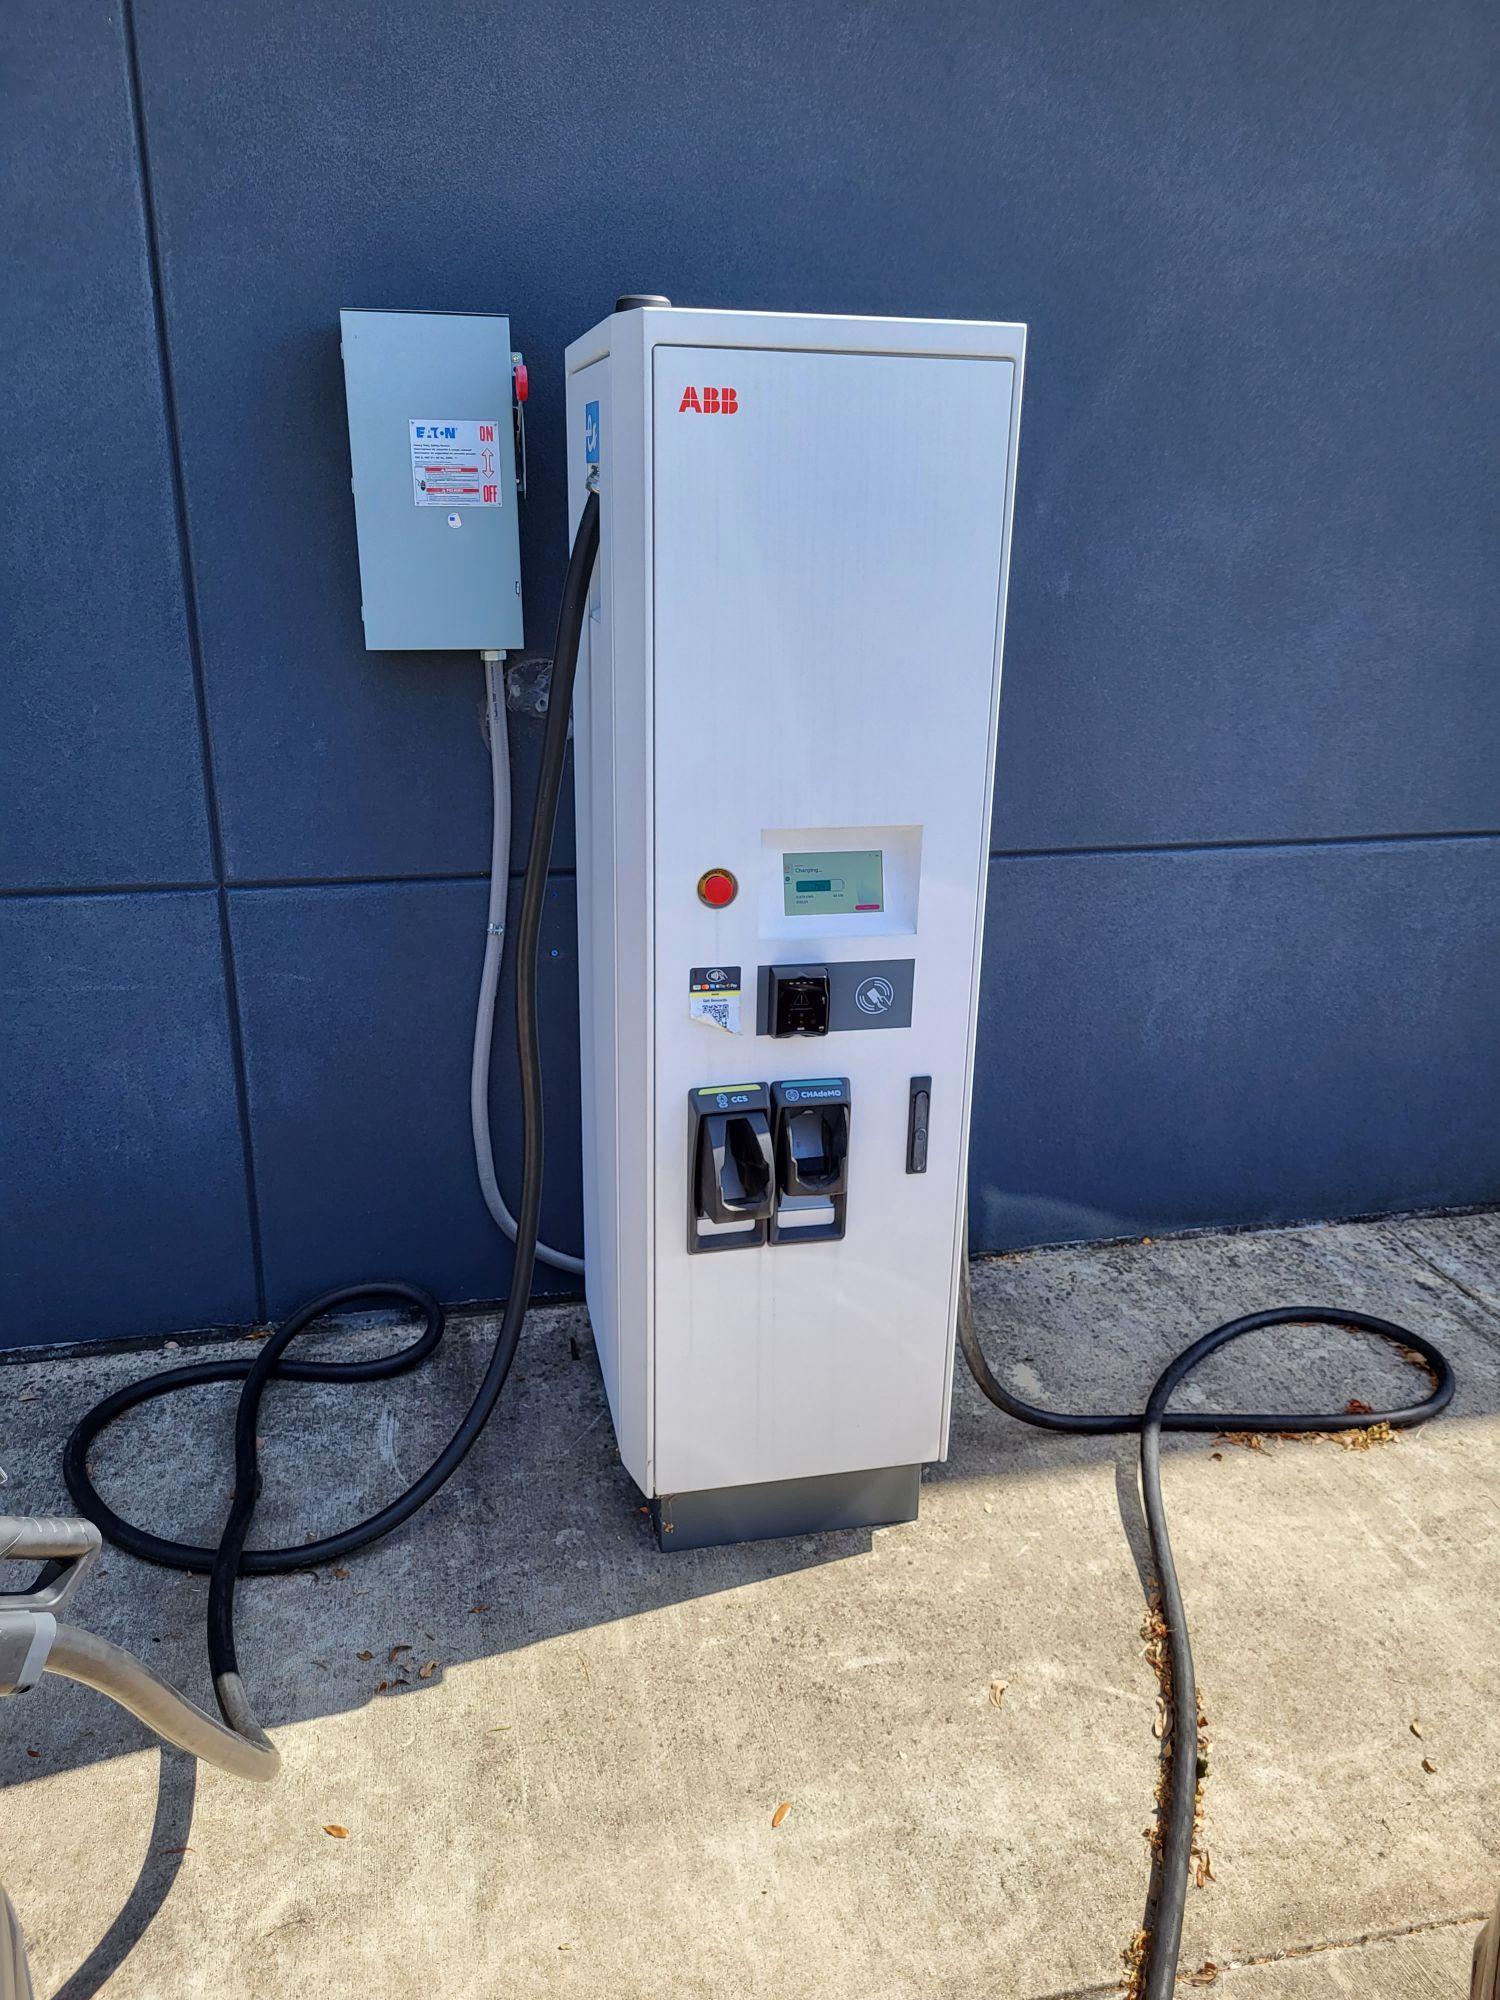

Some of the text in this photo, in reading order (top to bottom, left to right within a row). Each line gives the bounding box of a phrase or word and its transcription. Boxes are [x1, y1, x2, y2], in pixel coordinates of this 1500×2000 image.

[678, 386, 739, 415] ABB
[416, 426, 456, 439] EATON
[479, 425, 494, 442] ON
[483, 485, 498, 503] OFF
[800, 1089, 842, 1098] CHAdeMO
